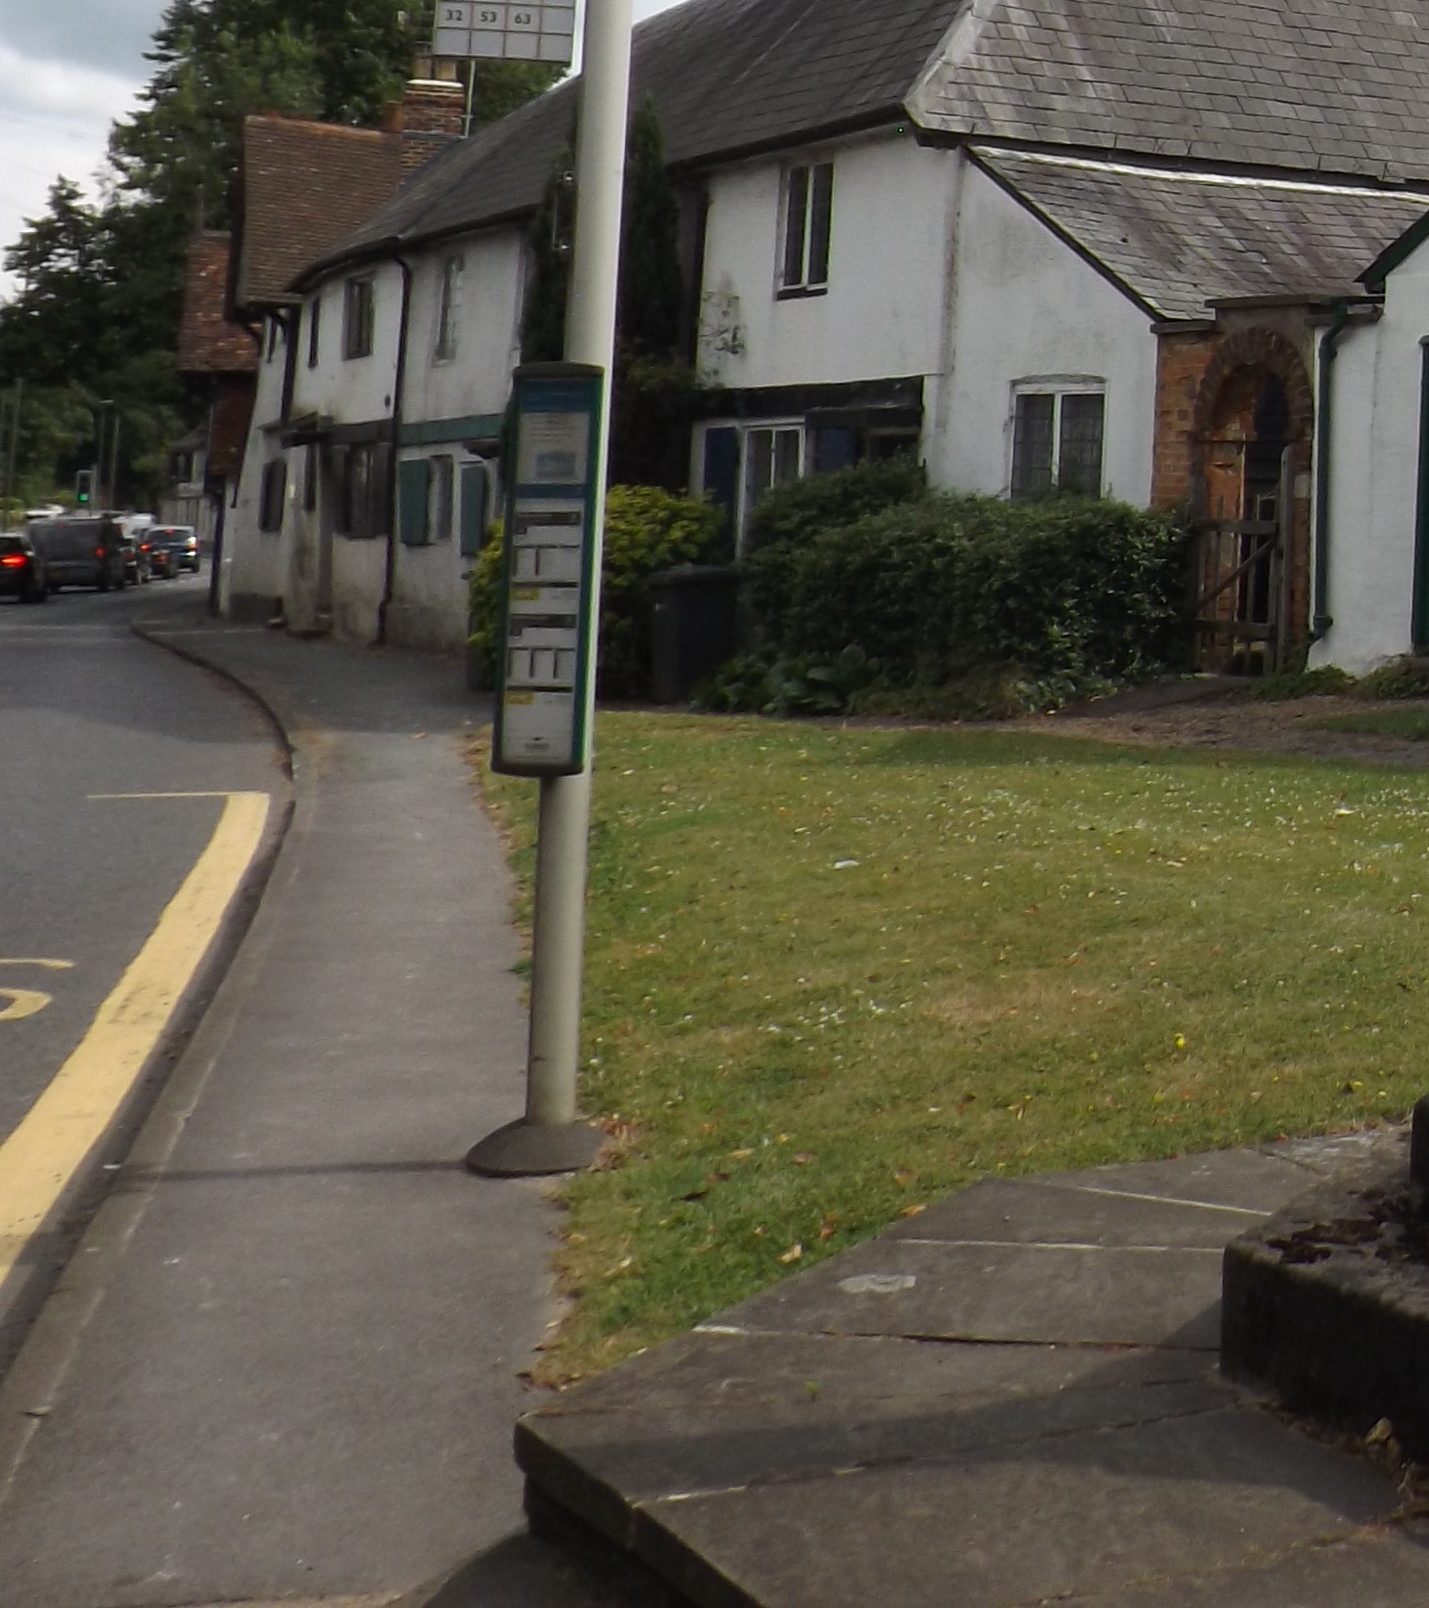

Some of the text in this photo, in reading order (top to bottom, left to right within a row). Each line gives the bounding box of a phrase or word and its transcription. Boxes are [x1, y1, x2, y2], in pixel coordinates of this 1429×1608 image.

[446, 9, 532, 24] 32 53 63
